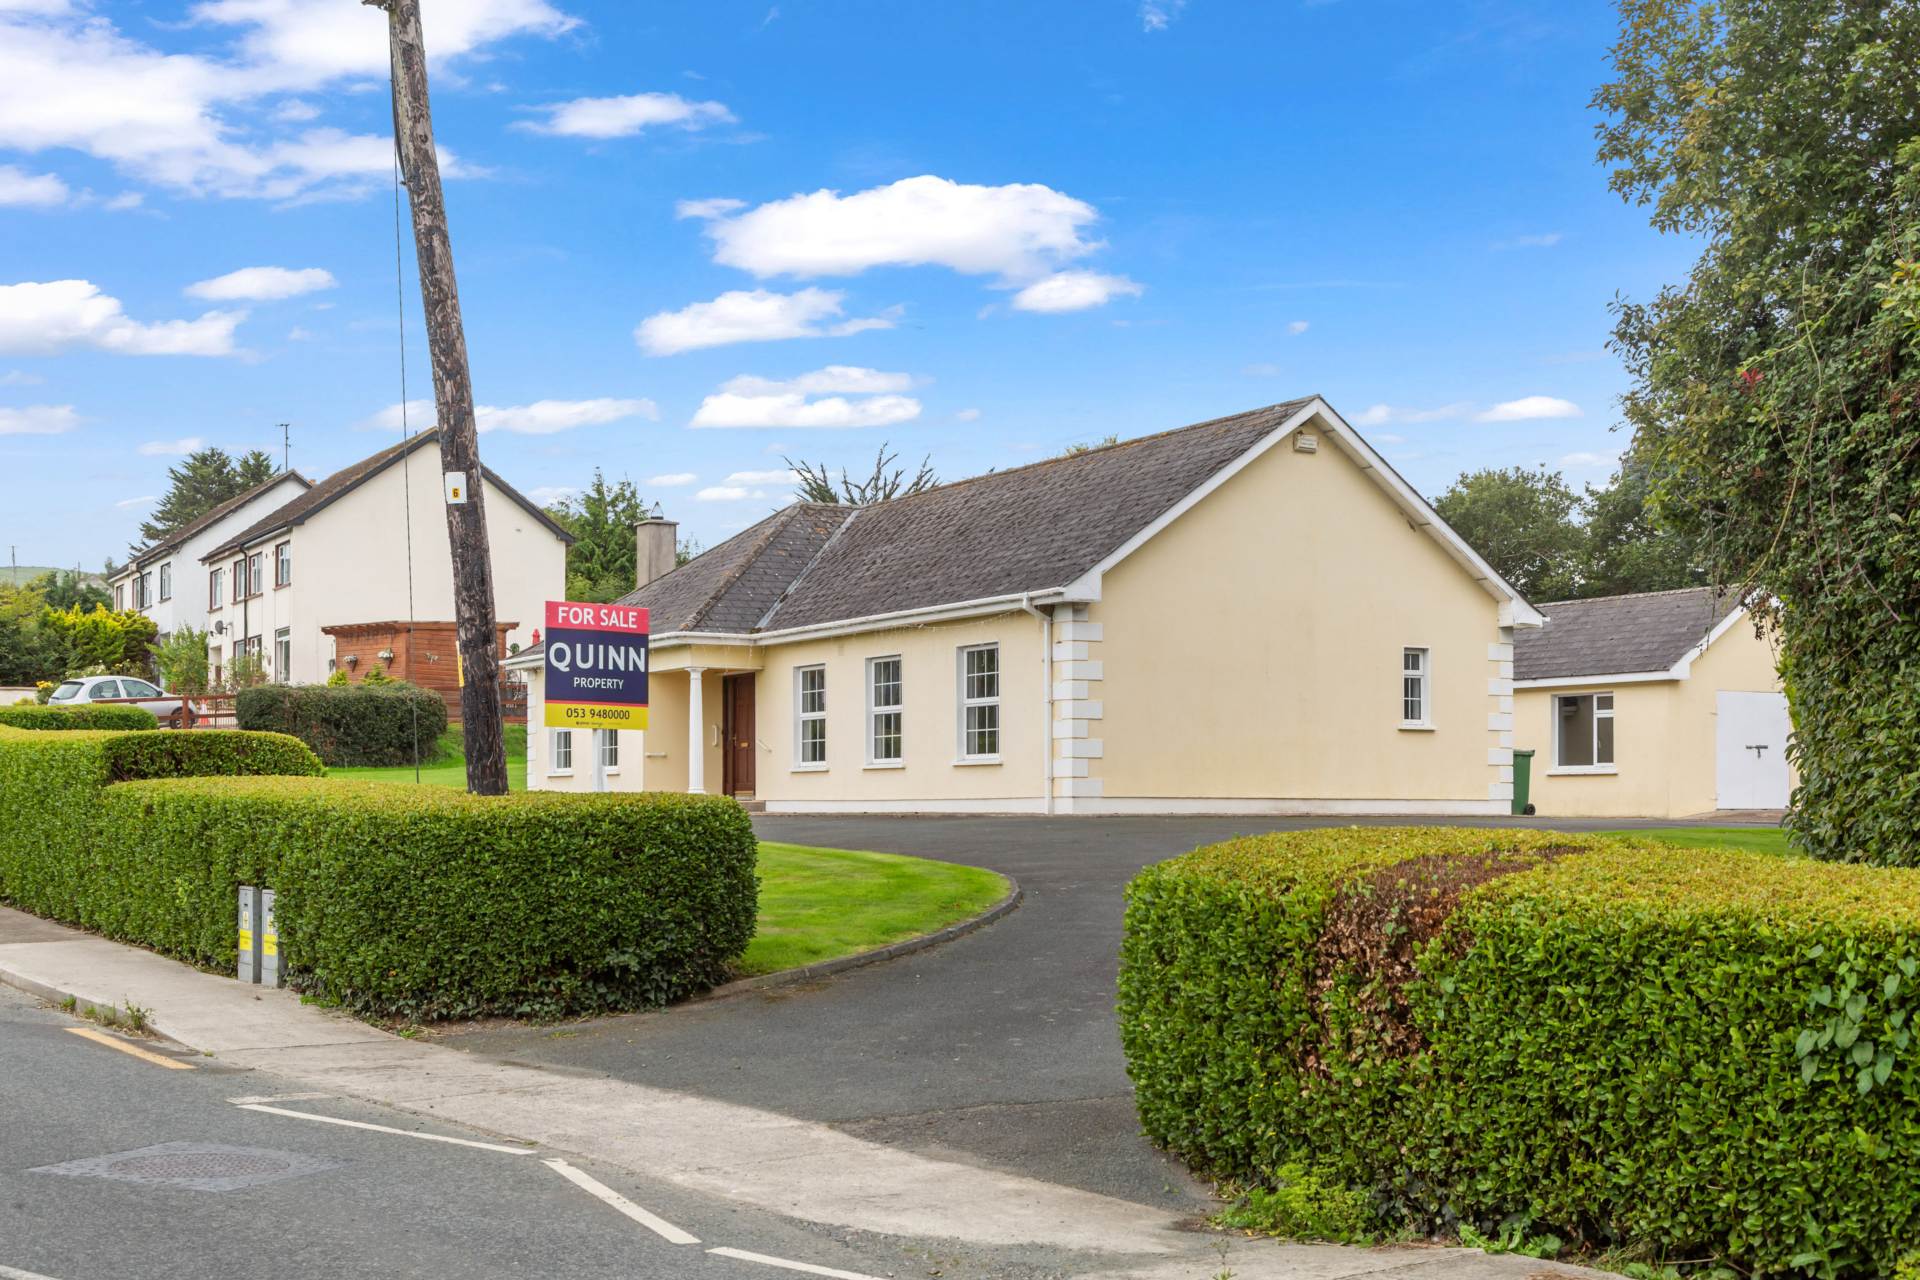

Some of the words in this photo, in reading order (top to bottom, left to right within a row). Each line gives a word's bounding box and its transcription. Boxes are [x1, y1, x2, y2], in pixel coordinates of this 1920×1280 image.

[452, 488, 460, 499] 6
[558, 606, 595, 625] FOR
[600, 609, 638, 628] SALE
[549, 642, 646, 673] QUINN
[573, 677, 624, 690] PROPERTY
[566, 708, 586, 718] 053
[589, 709, 630, 720] 9480000
